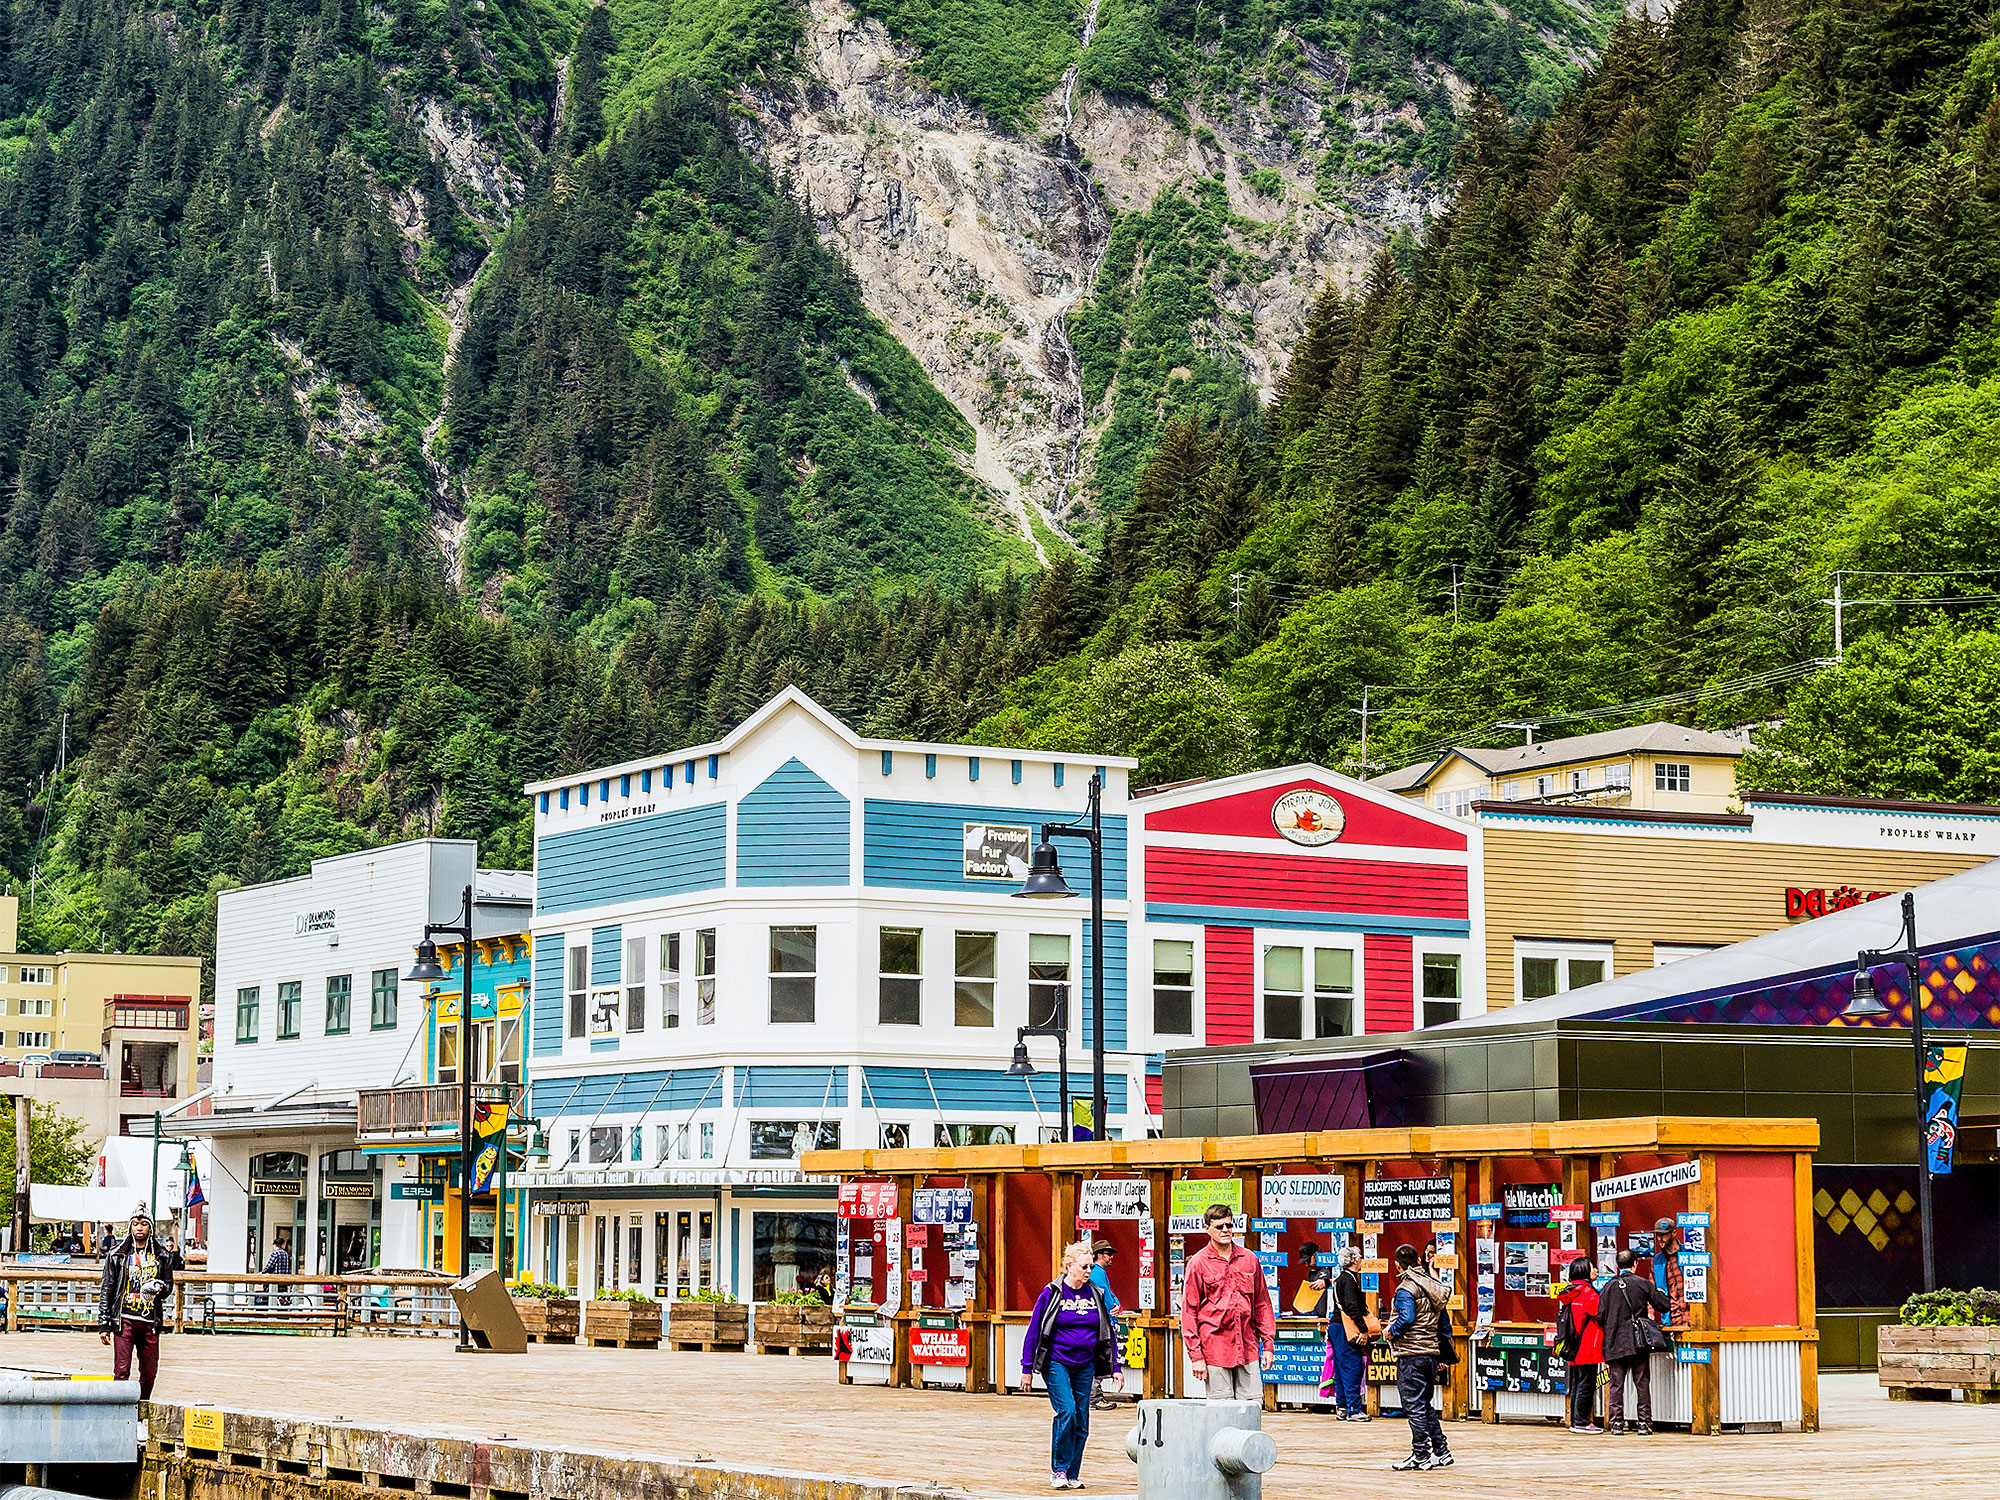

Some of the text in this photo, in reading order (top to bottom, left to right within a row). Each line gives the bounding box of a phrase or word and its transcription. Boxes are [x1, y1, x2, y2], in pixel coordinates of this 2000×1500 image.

[632, 804, 656, 816] WHARF
[1318, 799, 1338, 814] JOE
[987, 830, 1028, 842] Frontier
[1936, 831, 1976, 842] WHARF
[982, 846, 1002, 858] Fur
[966, 860, 1008, 876] Factory
[1786, 888, 1833, 918] DEL
[1364, 1179, 1450, 1192] HELICOPTERS FLOAT PLANES
[1595, 1164, 1696, 1198] WHALE WATCHING
[1085, 1182, 1147, 1196] Mendenhall Glacier
[1264, 1180, 1340, 1196] DOG SLEDDING
[1364, 1193, 1450, 1206] DOGSLED WHALE WATCHING
[850, 1204, 857, 1215] 15
[1084, 1201, 1088, 1213] &
[1093, 1201, 1112, 1214] Whale
[1365, 1208, 1451, 1220] ZIPLINE CITY & GLACIER TOURS
[1172, 1219, 1200, 1229] WHALE
[920, 1333, 958, 1345] WHALE
[857, 1345, 890, 1360] WATCHING
[912, 1345, 966, 1357] WATCHING
[1132, 1338, 1142, 1356] 15
[1372, 1349, 1398, 1362] GLAC
[1681, 1350, 1708, 1360] BLUE BUS
[1520, 1358, 1531, 1368] City
[1548, 1357, 1559, 1368] City
[1368, 1365, 1397, 1380] EXPR
[1486, 1368, 1504, 1376] Glacier
[1548, 1368, 1566, 1377] Glacier
